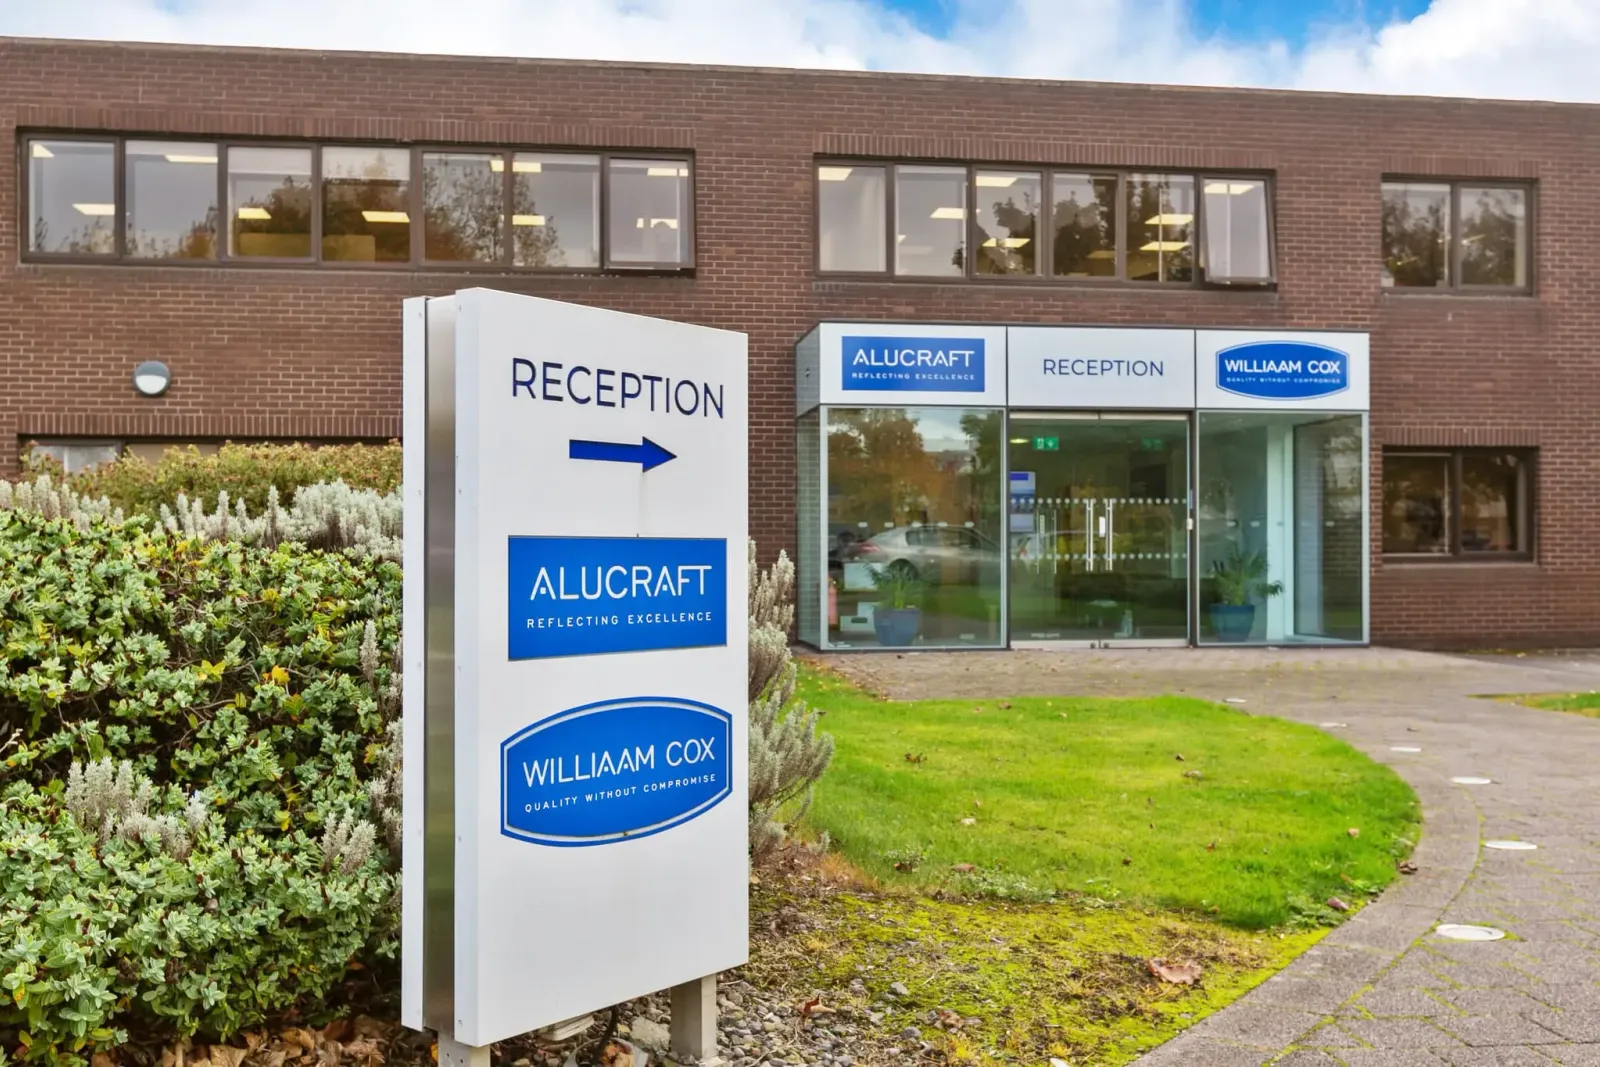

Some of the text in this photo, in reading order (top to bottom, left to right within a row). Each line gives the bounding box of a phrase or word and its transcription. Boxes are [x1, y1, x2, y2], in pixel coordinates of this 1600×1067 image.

[852, 349, 975, 367] ALUCRAFT
[1307, 360, 1340, 374] COX
[852, 372, 975, 381] REFLECTING EXCELLENCE
[1043, 359, 1164, 376] RECEPTION
[512, 357, 724, 419] RECEPTION
[530, 565, 712, 601] ALUCRAFT
[527, 612, 712, 629] REFLECTING EXCELLENCE
[666, 736, 715, 767] COX
[524, 774, 716, 813] QUALITY WITHOUT COMPROMISE
